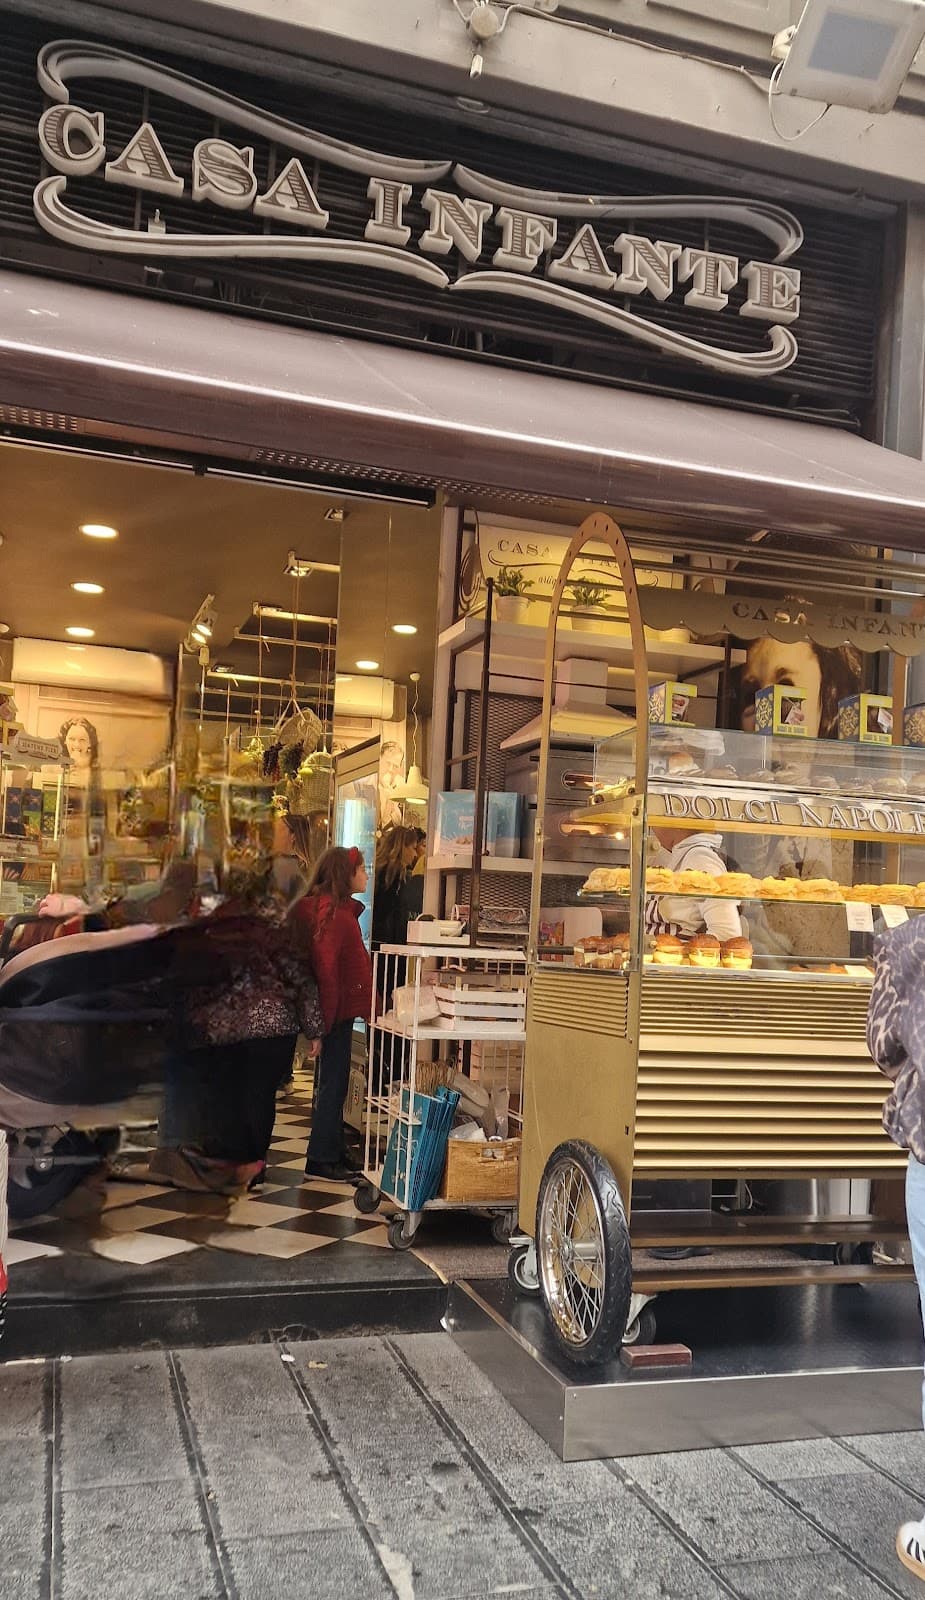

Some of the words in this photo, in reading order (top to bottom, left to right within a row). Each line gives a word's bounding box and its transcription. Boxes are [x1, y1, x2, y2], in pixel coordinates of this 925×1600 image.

[38, 104, 329, 230] CASA
[364, 177, 801, 323] INFANTE
[732, 602, 814, 627] CASA
[663, 793, 782, 825] DOLCI
